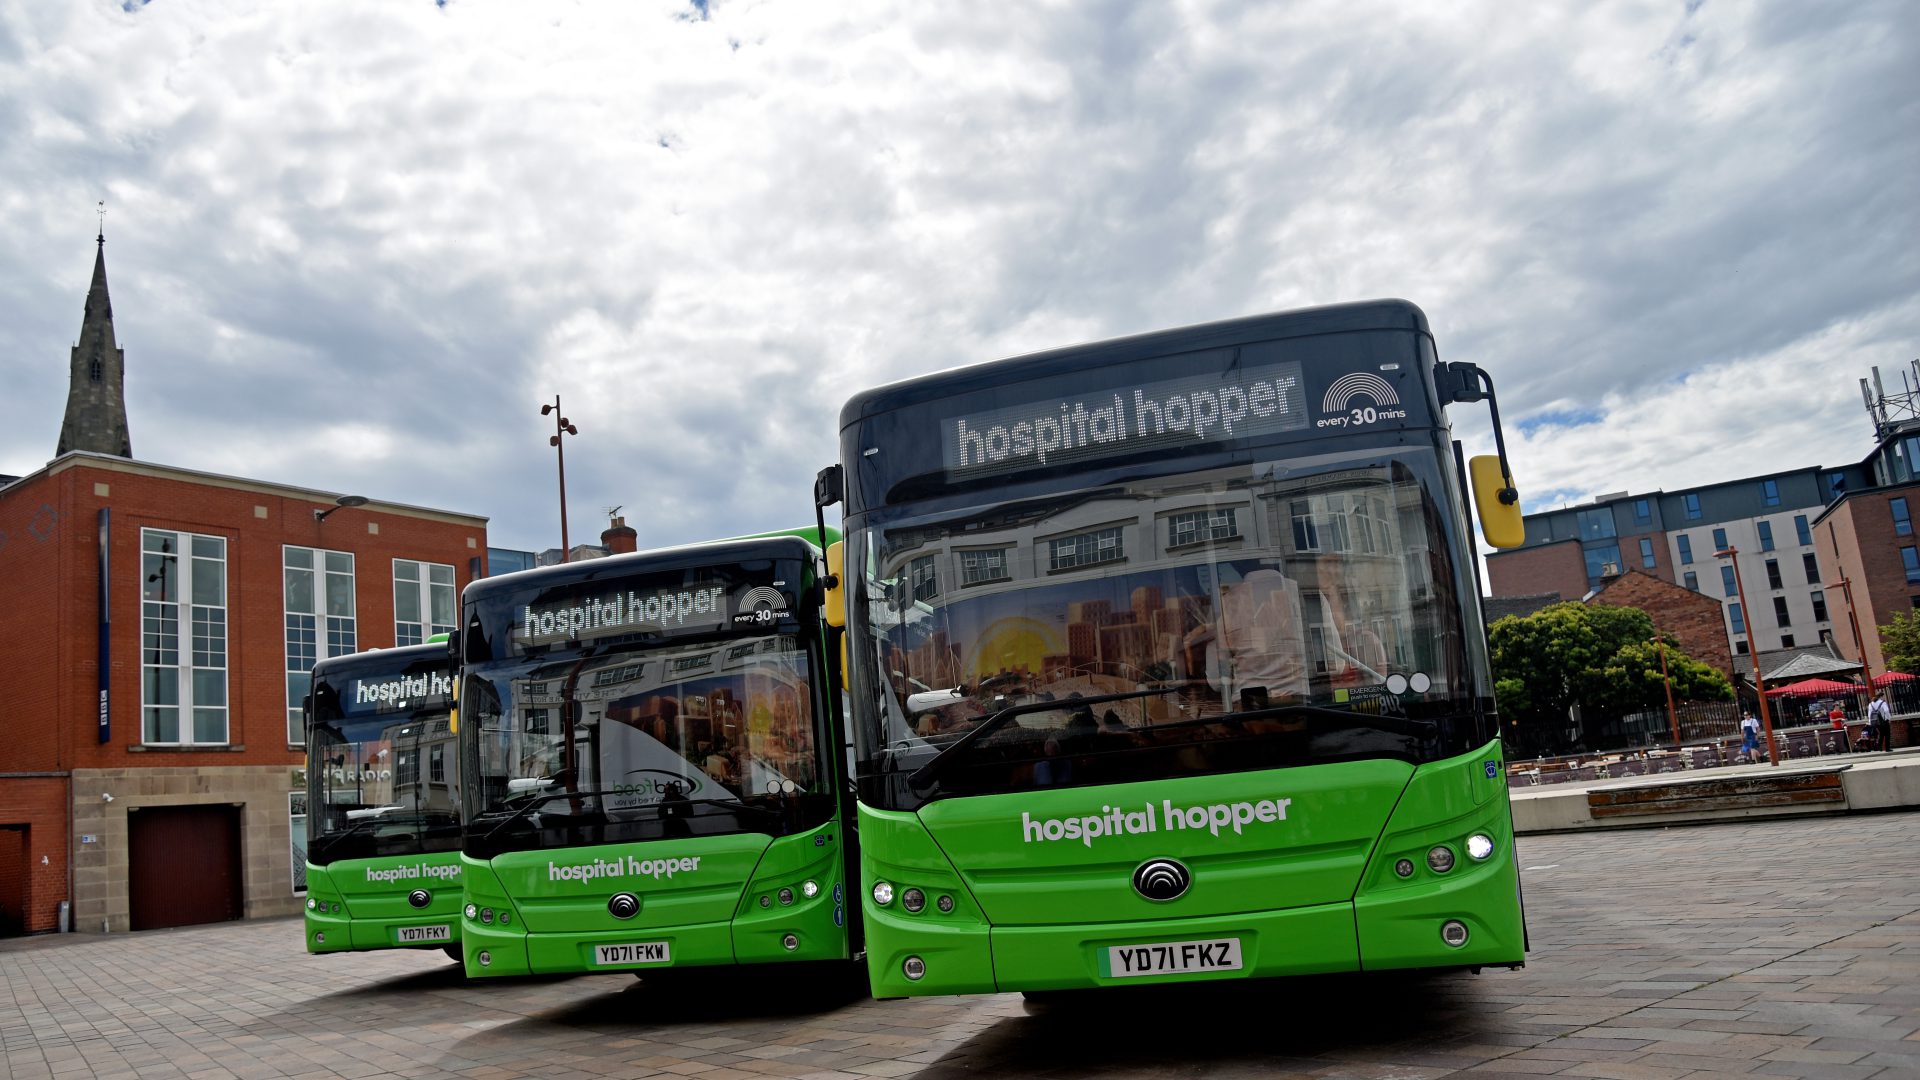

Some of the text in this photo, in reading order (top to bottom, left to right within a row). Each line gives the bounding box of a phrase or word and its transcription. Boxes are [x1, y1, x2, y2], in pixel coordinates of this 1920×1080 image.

[957, 376, 1296, 465] hospital hopper
[1317, 407, 1406, 427] every 30 mins
[524, 587, 723, 639] hospital hopper
[734, 609, 790, 623] every 30 mins
[356, 672, 428, 705] hospital
[1350, 686, 1387, 695] EMERGENC
[1022, 798, 1291, 848] hospital hopper
[366, 863, 461, 884] hospital hopp
[548, 855, 701, 885] hospital hopper
[402, 926, 446, 940] YD71 FKY
[601, 944, 663, 961] YD71 FKW
[1119, 942, 1232, 972] YD71 FKZ
